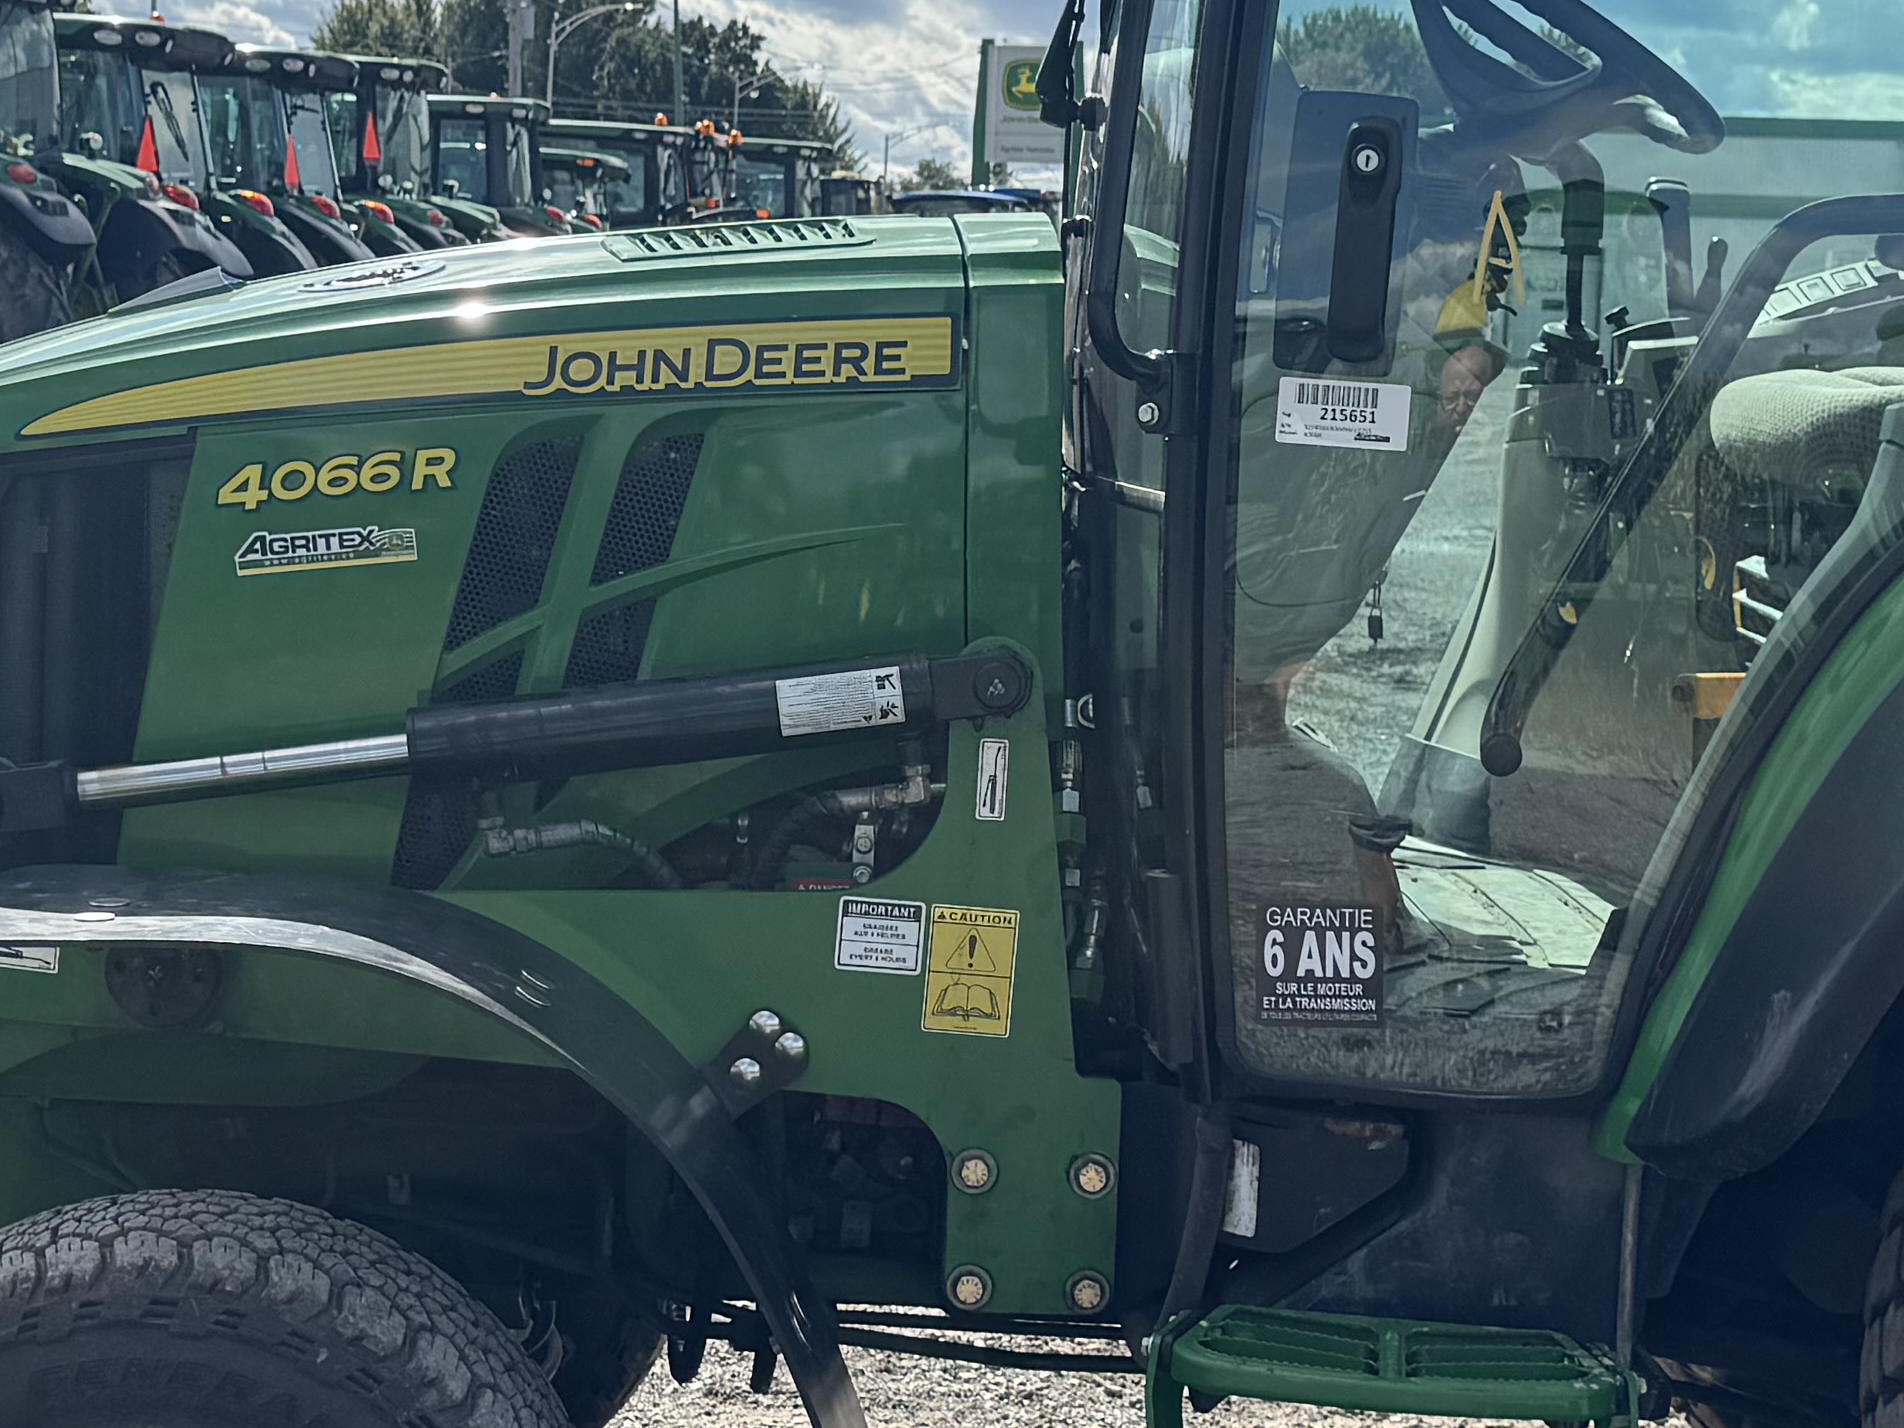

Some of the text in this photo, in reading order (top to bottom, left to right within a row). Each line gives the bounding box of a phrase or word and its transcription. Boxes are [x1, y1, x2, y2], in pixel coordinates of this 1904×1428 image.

[523, 337, 909, 390] JOHN DEERE
[1319, 407, 1377, 424] 215651
[237, 529, 379, 559] AGRITEX
[848, 902, 917, 918] IMPORTANT
[948, 911, 1013, 925] CAUTION
[1266, 906, 1374, 929] GARANTIE
[1263, 929, 1376, 979] 6 ANS
[1275, 981, 1364, 996] SUR LE MOTEUR
[1262, 996, 1376, 1011] ET LA TRANSMISSION
